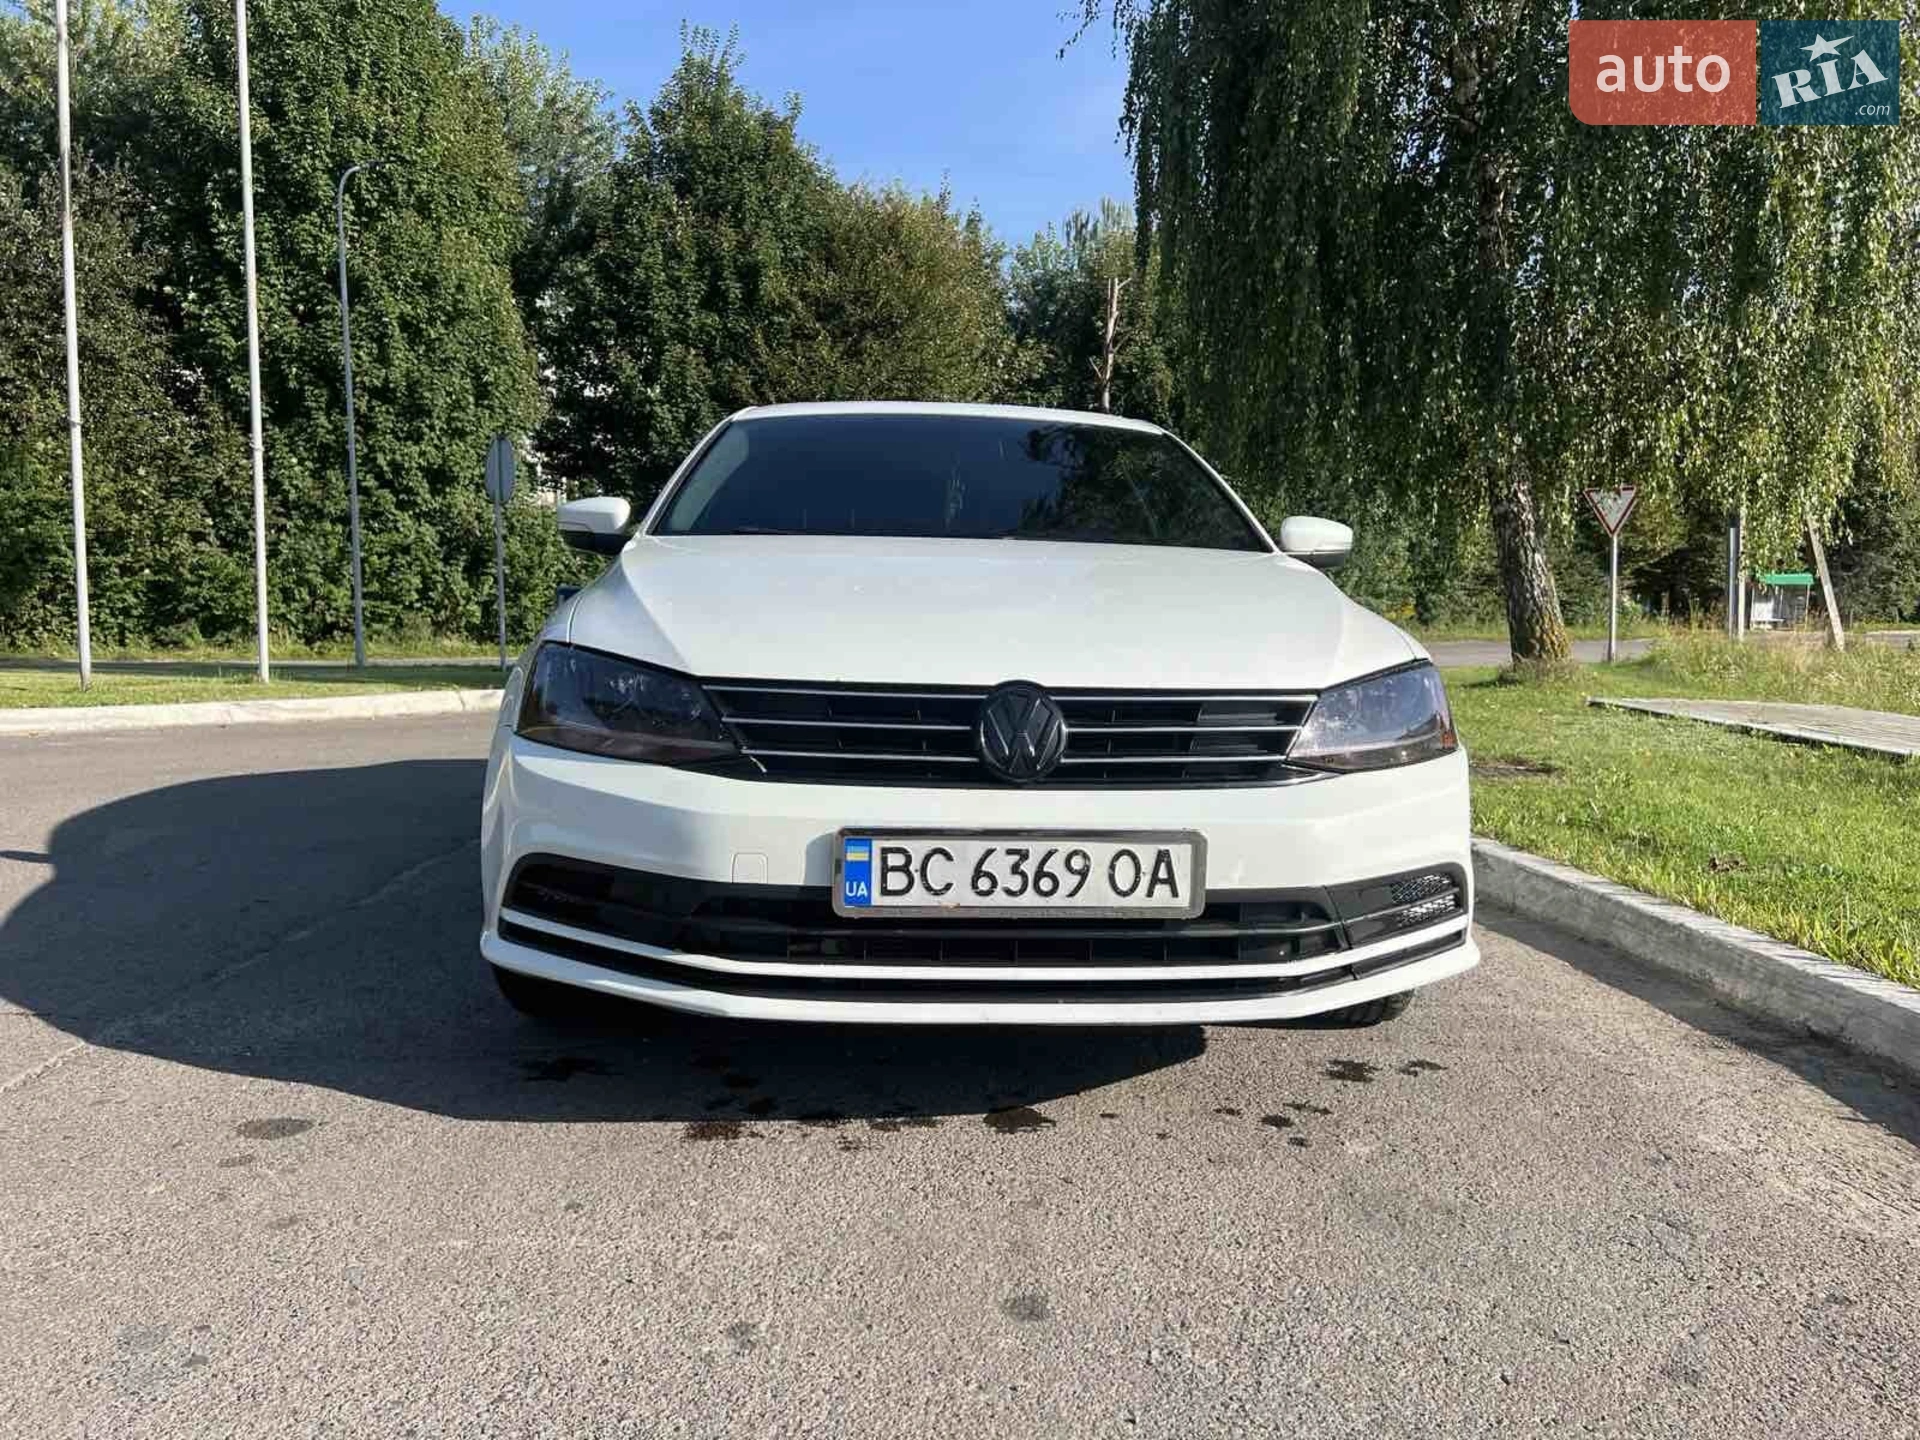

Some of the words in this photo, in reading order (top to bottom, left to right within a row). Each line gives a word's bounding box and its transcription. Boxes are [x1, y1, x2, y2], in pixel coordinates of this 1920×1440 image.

[845, 881, 868, 897] UA
[879, 846, 954, 896] BC
[971, 847, 1091, 898] 6369
[1108, 848, 1179, 898] OA
